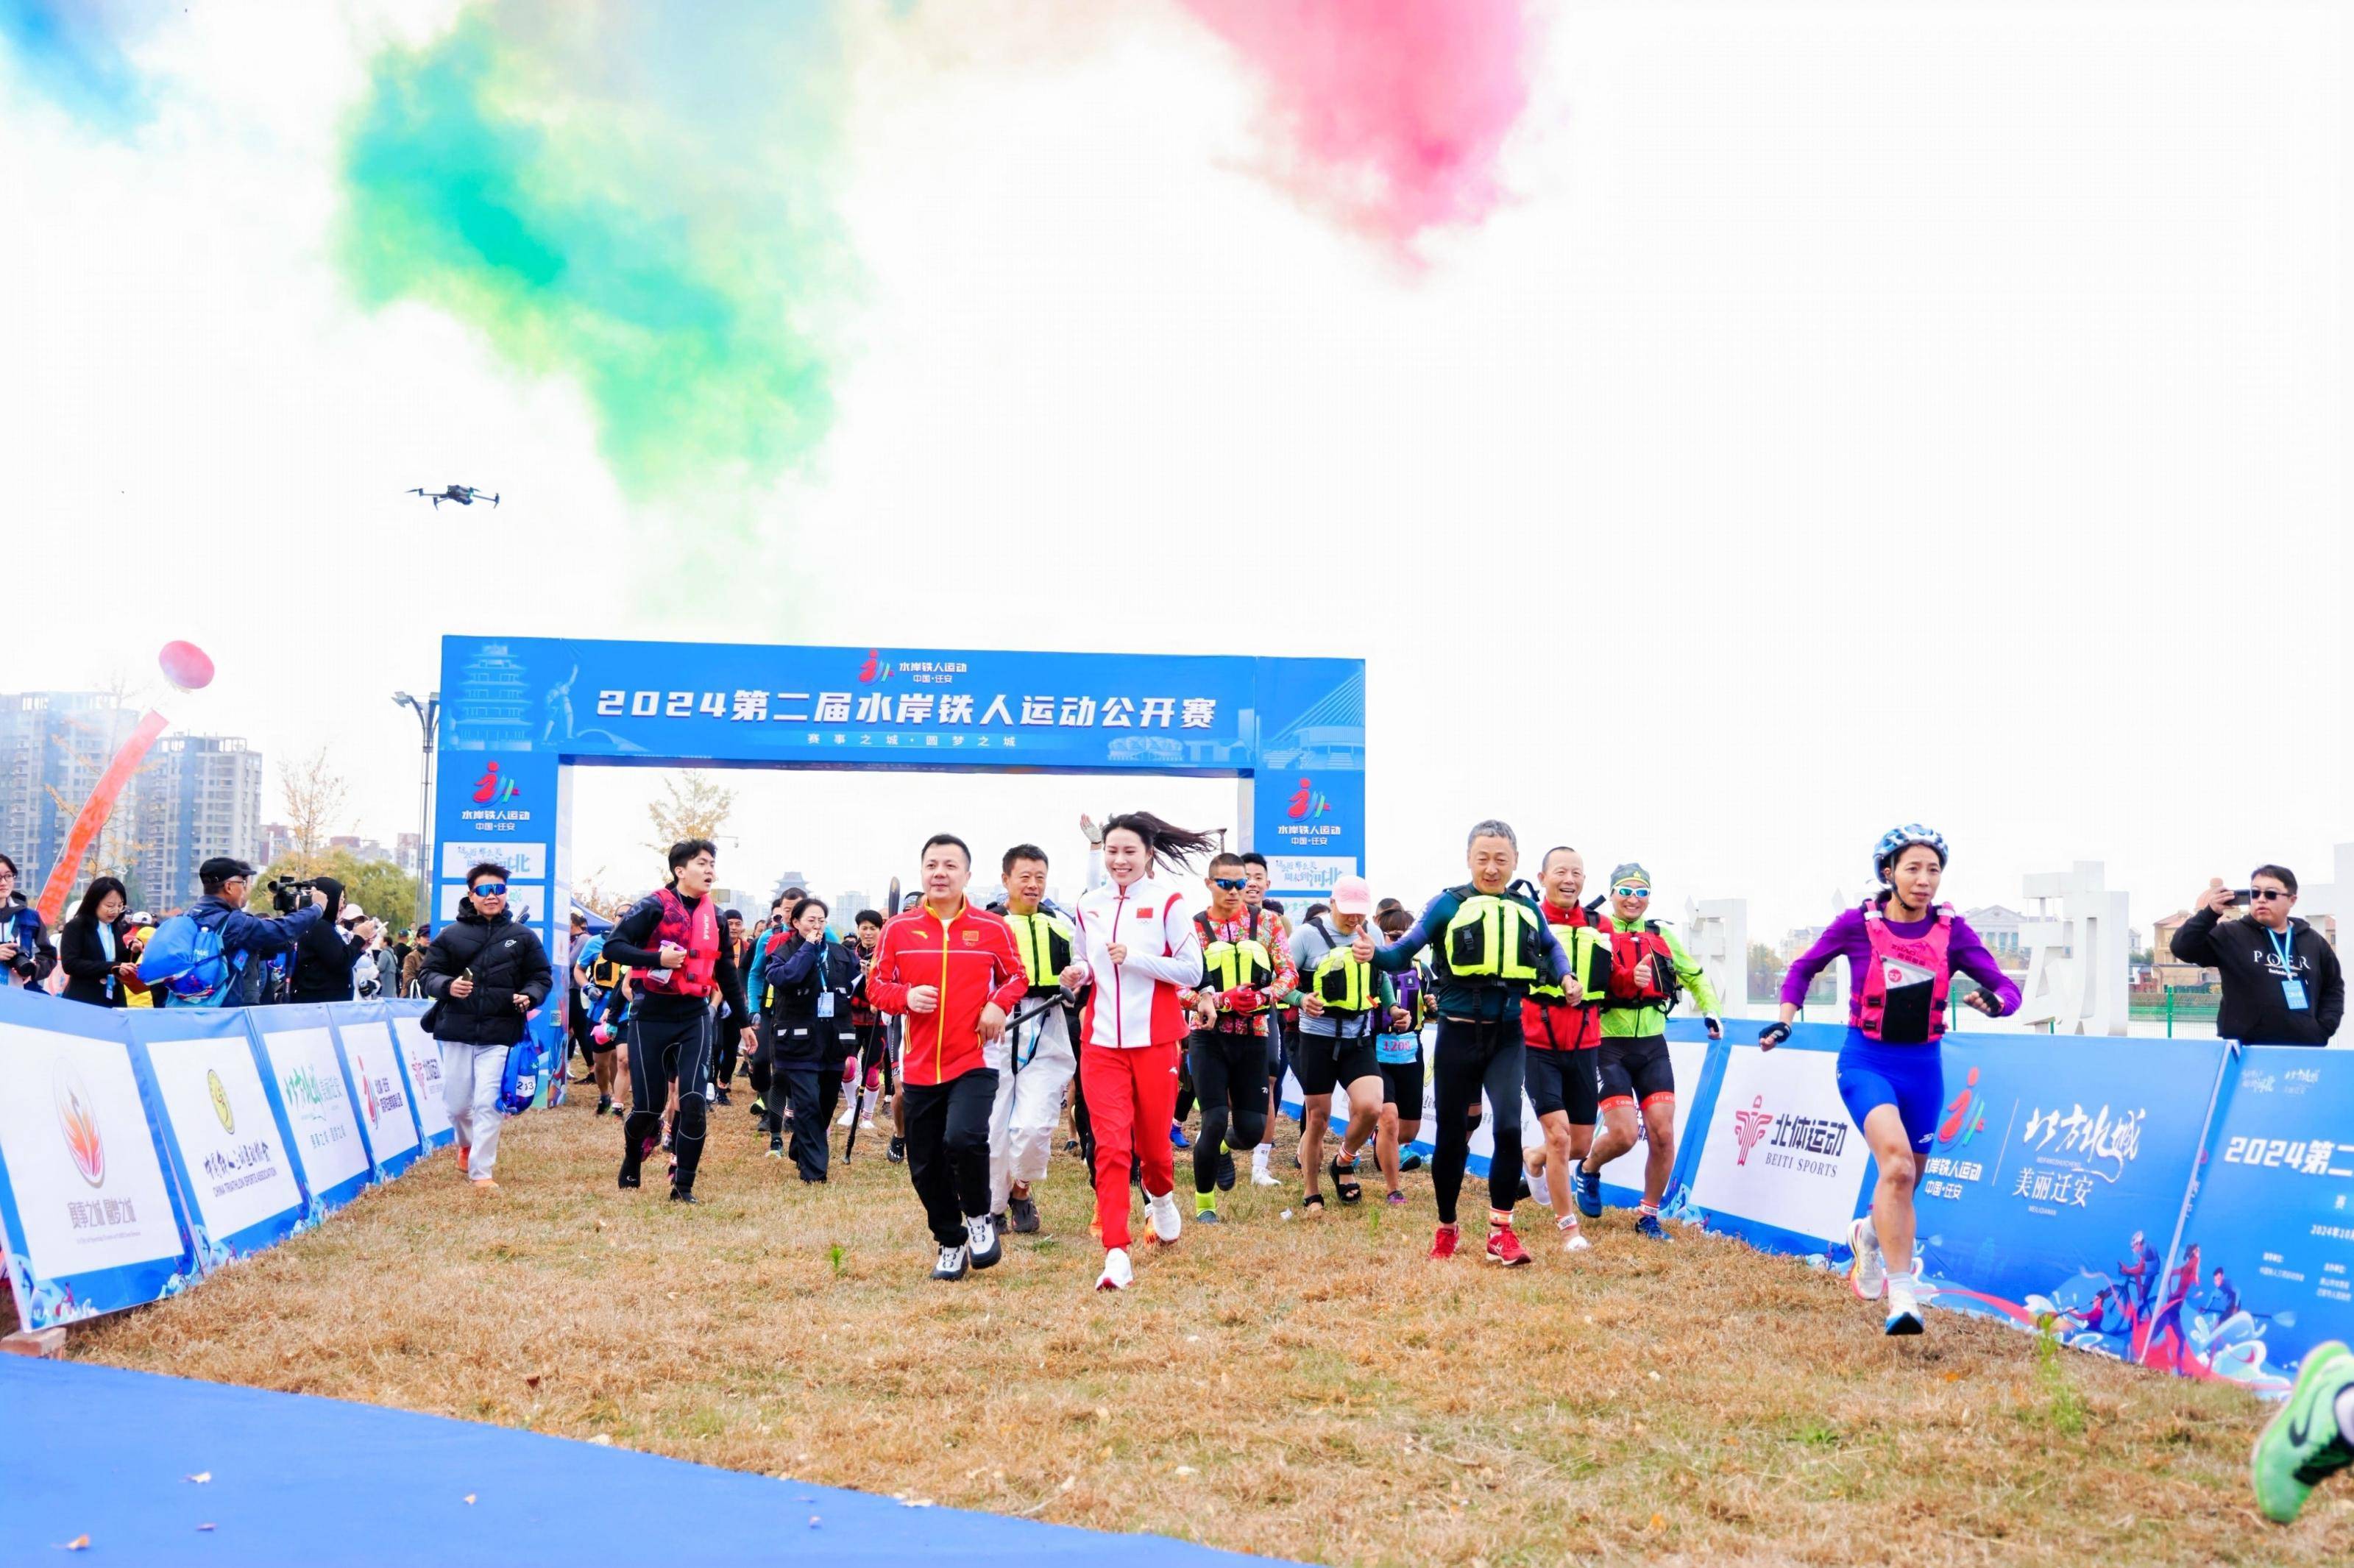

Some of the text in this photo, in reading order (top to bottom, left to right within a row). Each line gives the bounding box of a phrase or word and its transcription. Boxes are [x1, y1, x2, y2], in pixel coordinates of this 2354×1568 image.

[899, 662, 967, 673] 水岸铁人运动
[596, 689, 1216, 728] 2024第二届水岸铁人运动公开赛
[461, 810, 531, 820] 水岸铁人运动
[1277, 826, 1341, 835] 水岸铁人运动
[1770, 1113, 1848, 1157] 北体运动
[1765, 1152, 1838, 1178] BEITI SPORTS
[2224, 1136, 2354, 1177] 2024第二
[2012, 1167, 2094, 1208] 美丽迁安
